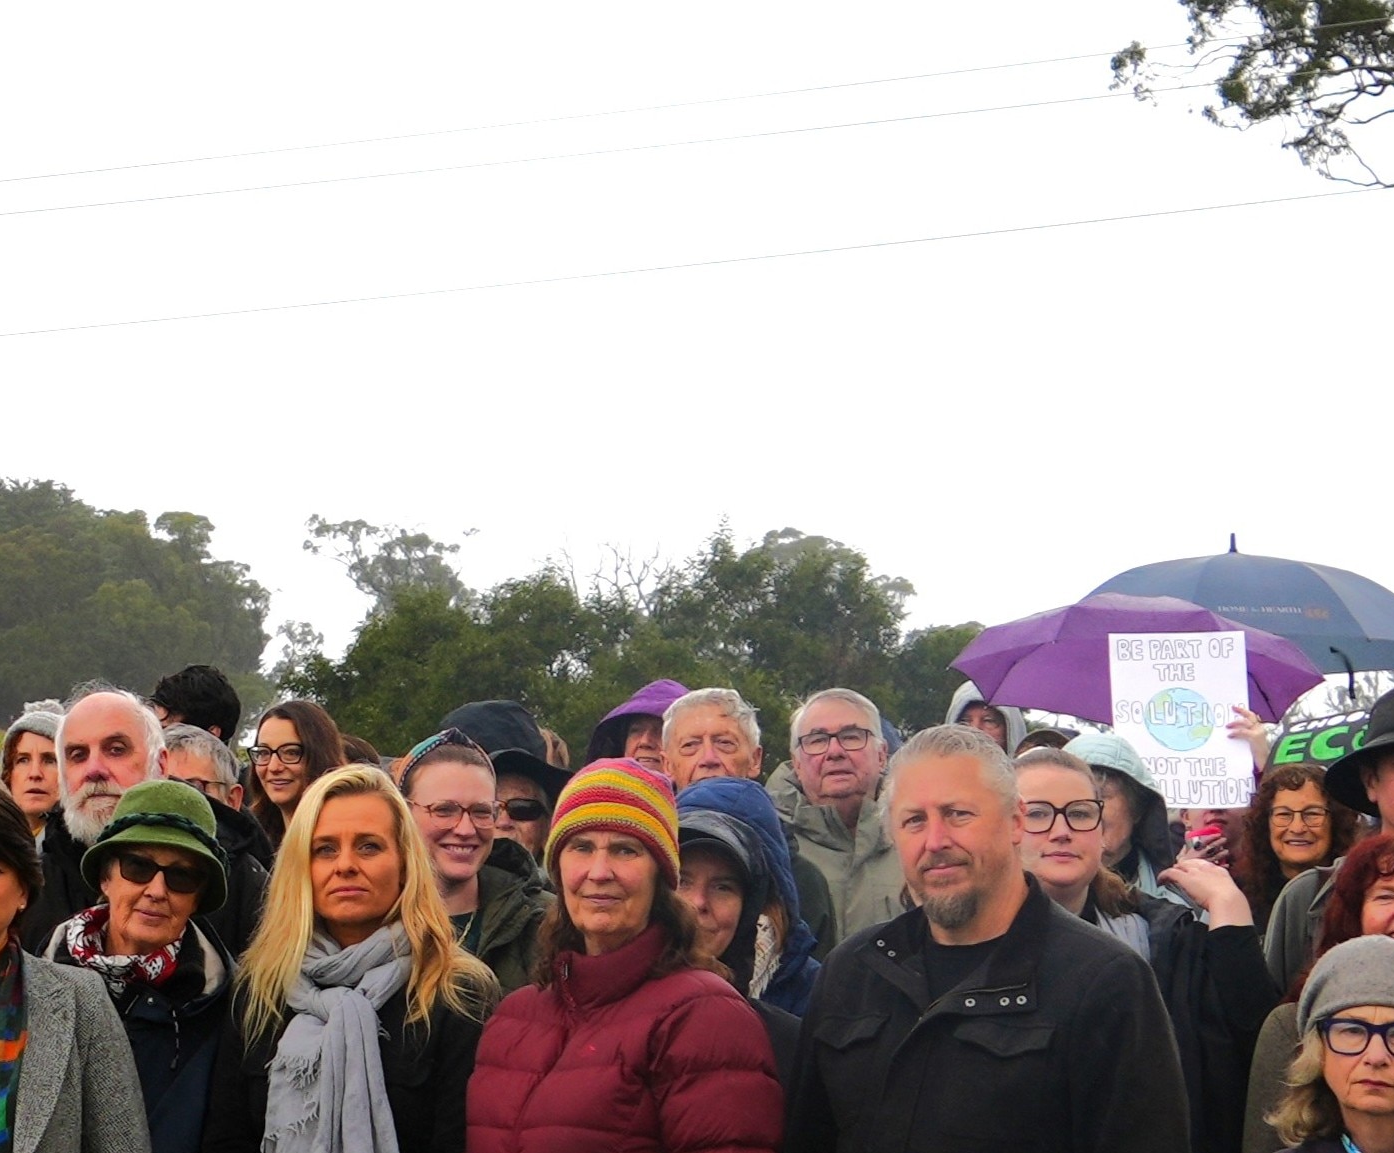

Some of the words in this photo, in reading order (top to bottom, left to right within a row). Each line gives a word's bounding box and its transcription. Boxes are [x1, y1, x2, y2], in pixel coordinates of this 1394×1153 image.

[1116, 639, 1144, 661] BE
[1148, 639, 1203, 660] PART
[1208, 637, 1234, 659] OF
[1152, 662, 1195, 682] THE
[1289, 710, 1371, 733] CHOO
[1141, 757, 1181, 775] NOT
[1184, 757, 1226, 777] THE
[1155, 776, 1257, 806] LLUTION
